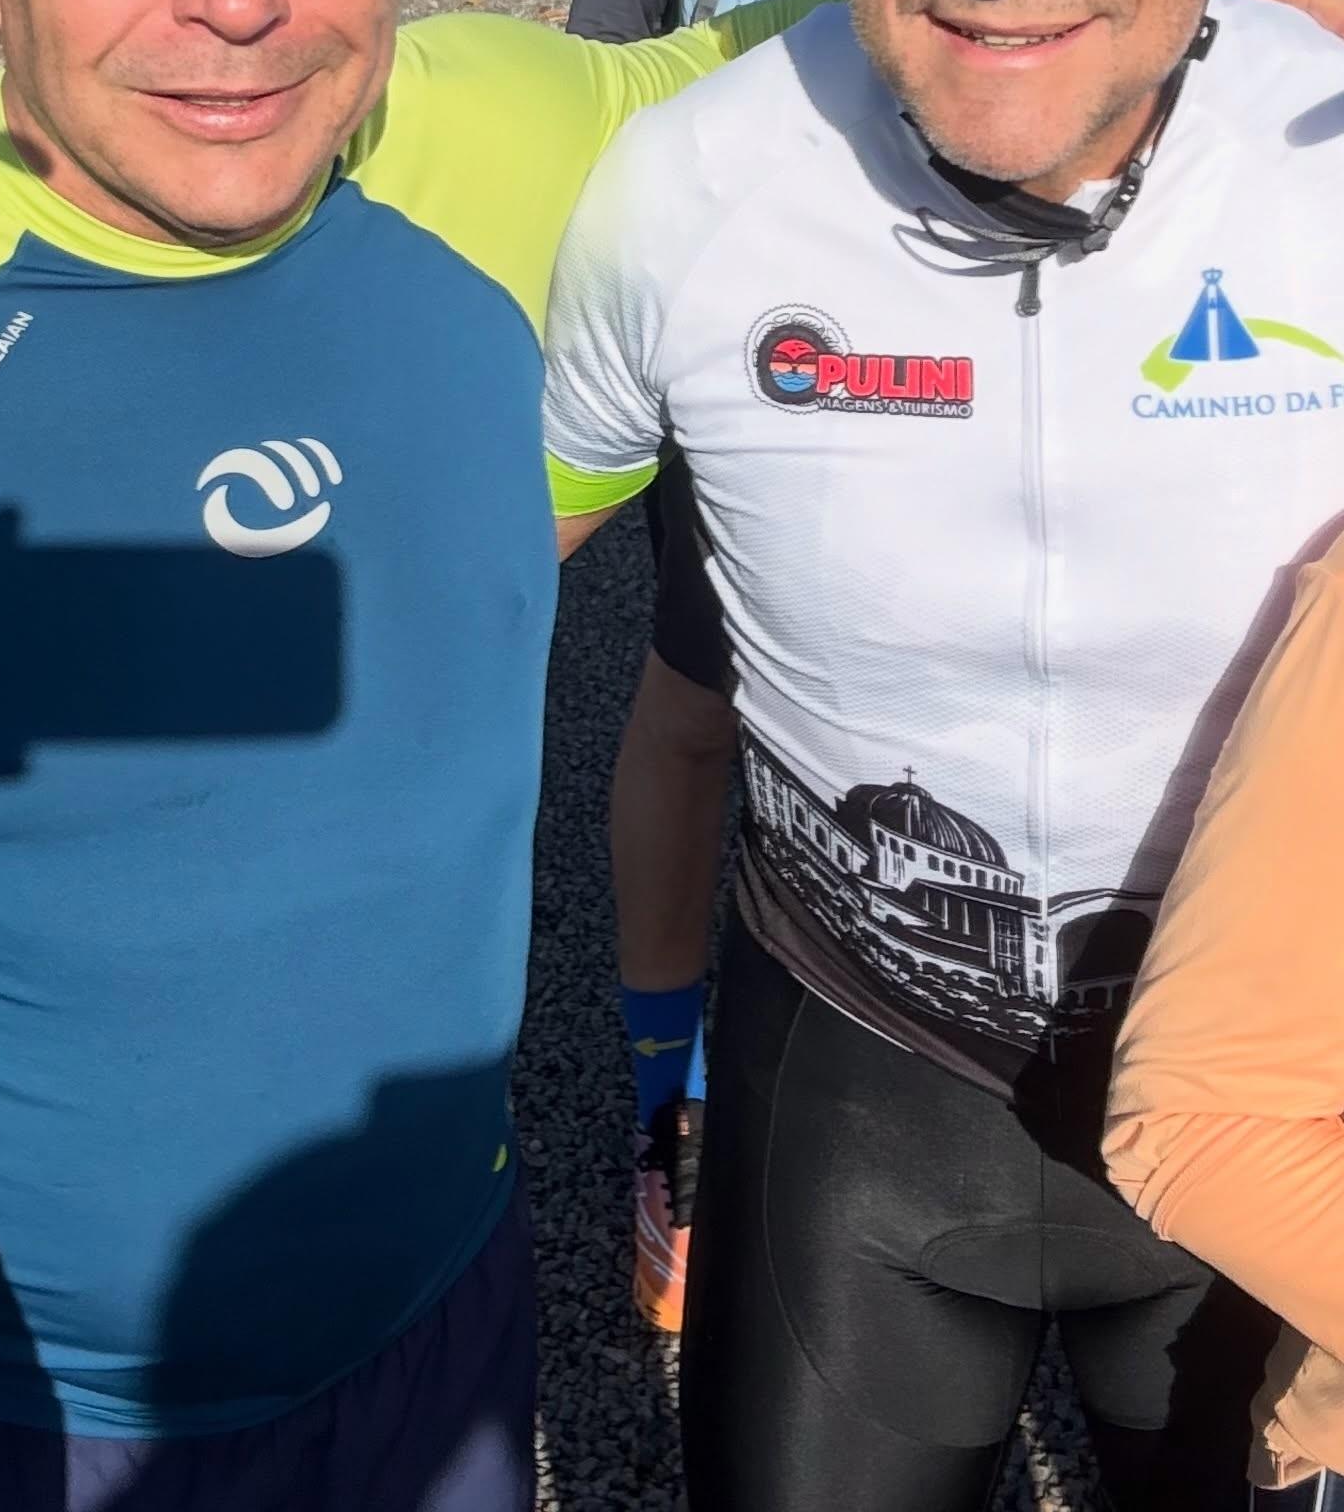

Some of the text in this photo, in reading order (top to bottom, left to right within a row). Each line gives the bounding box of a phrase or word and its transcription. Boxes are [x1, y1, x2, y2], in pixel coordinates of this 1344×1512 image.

[816, 355, 973, 400] PULINI
[816, 398, 972, 417] VIAGENS & TURISMO
[1132, 394, 1276, 418] CAMINHO
[1286, 391, 1322, 413] DA
